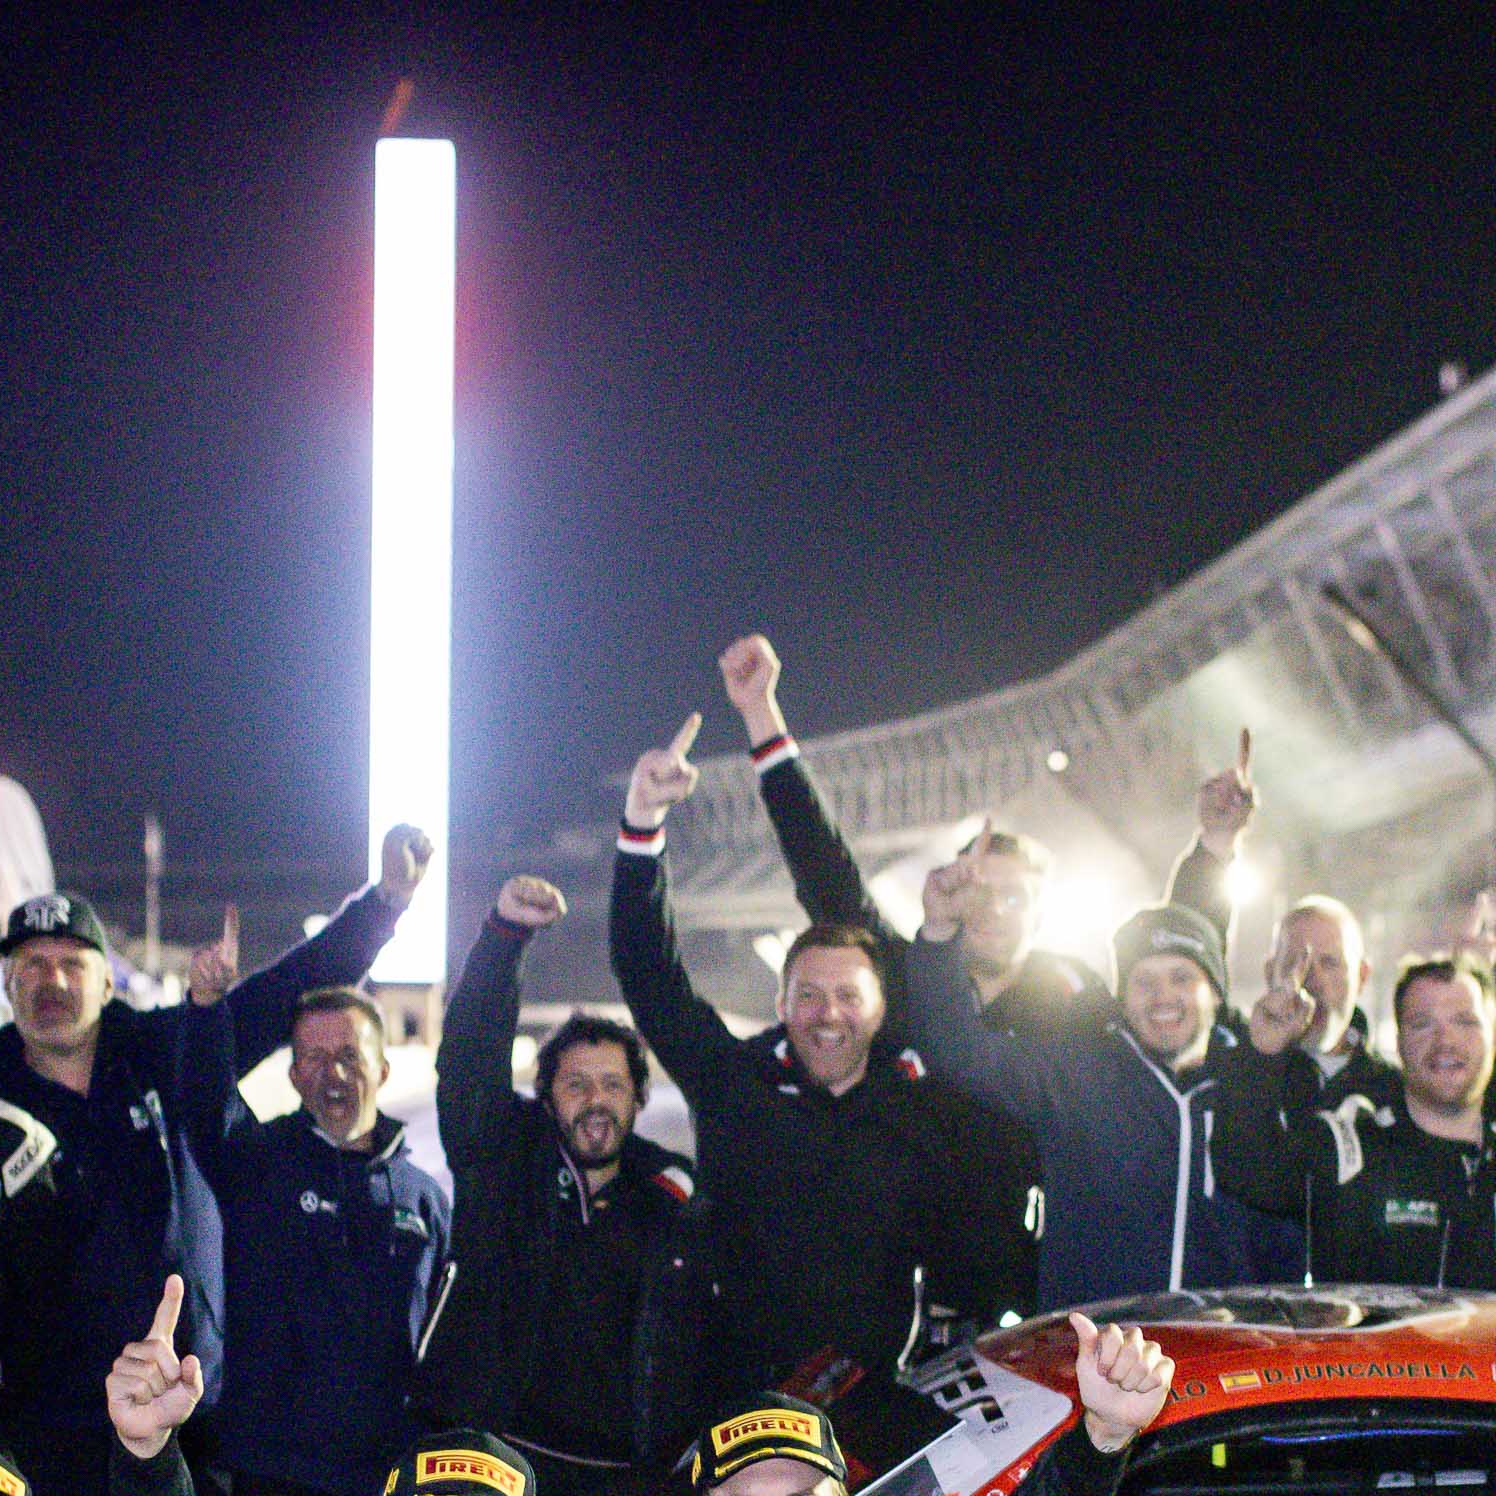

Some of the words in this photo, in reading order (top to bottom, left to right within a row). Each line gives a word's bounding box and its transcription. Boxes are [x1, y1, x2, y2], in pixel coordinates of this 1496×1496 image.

[1263, 1362, 1477, 1385] D.JUNCADELLA
[719, 1413, 810, 1444] PIRELLI
[425, 1456, 516, 1493] PIRELLI
